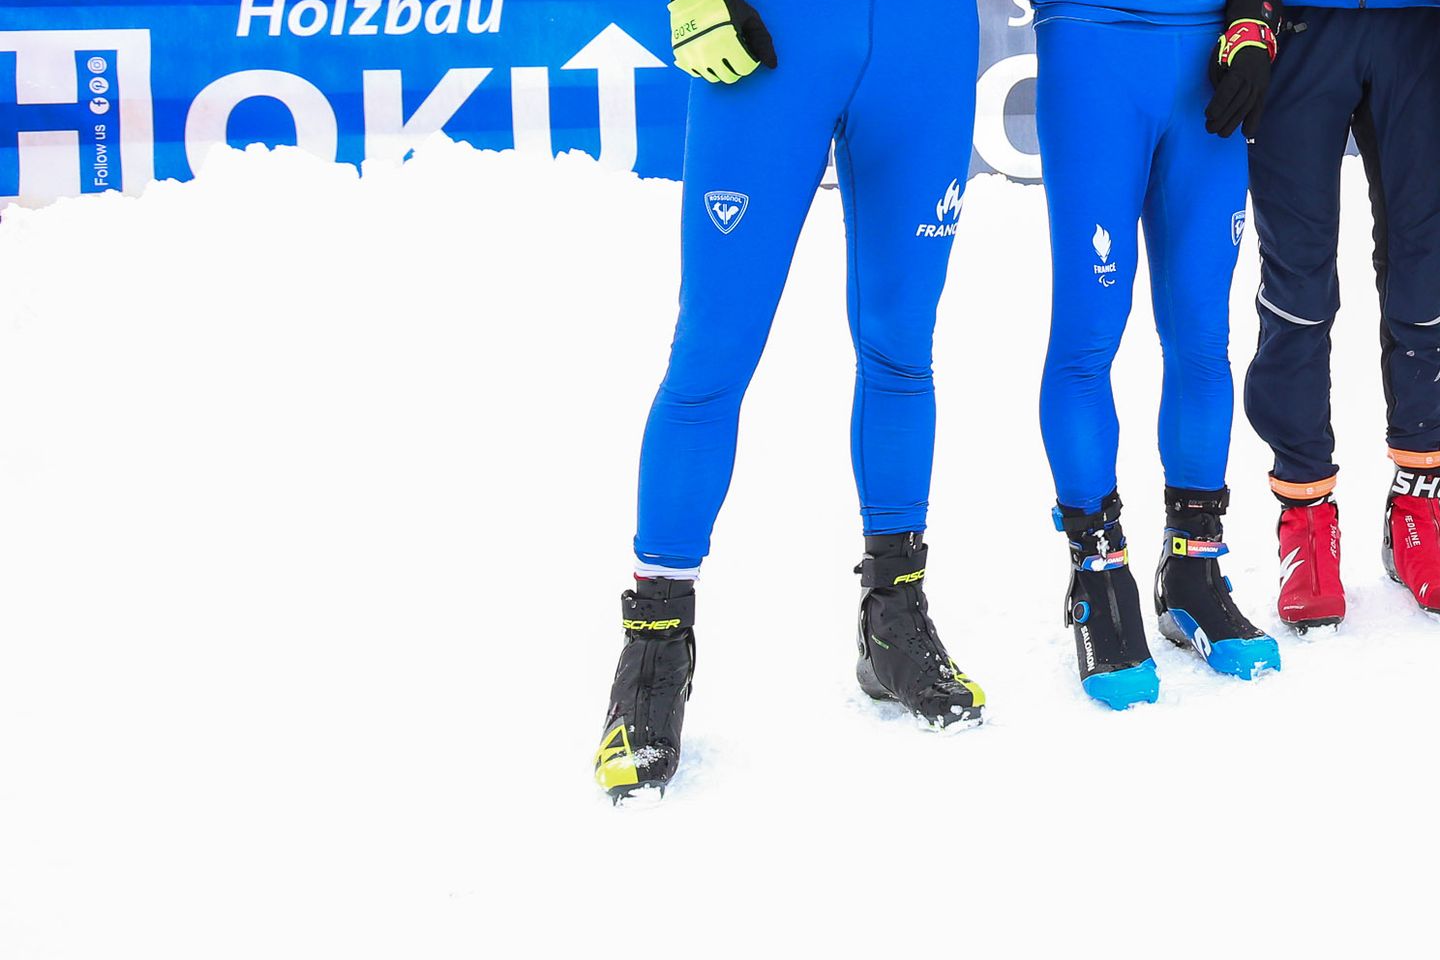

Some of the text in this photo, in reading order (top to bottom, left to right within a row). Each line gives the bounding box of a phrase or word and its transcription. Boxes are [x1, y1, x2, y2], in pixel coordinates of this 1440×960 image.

[673, 19, 698, 40] GORE
[93, 124, 109, 187] Follow us
[916, 223, 960, 237] FRANC
[1094, 262, 1116, 273] FRANCE
[1080, 626, 1095, 671] SALOMON
